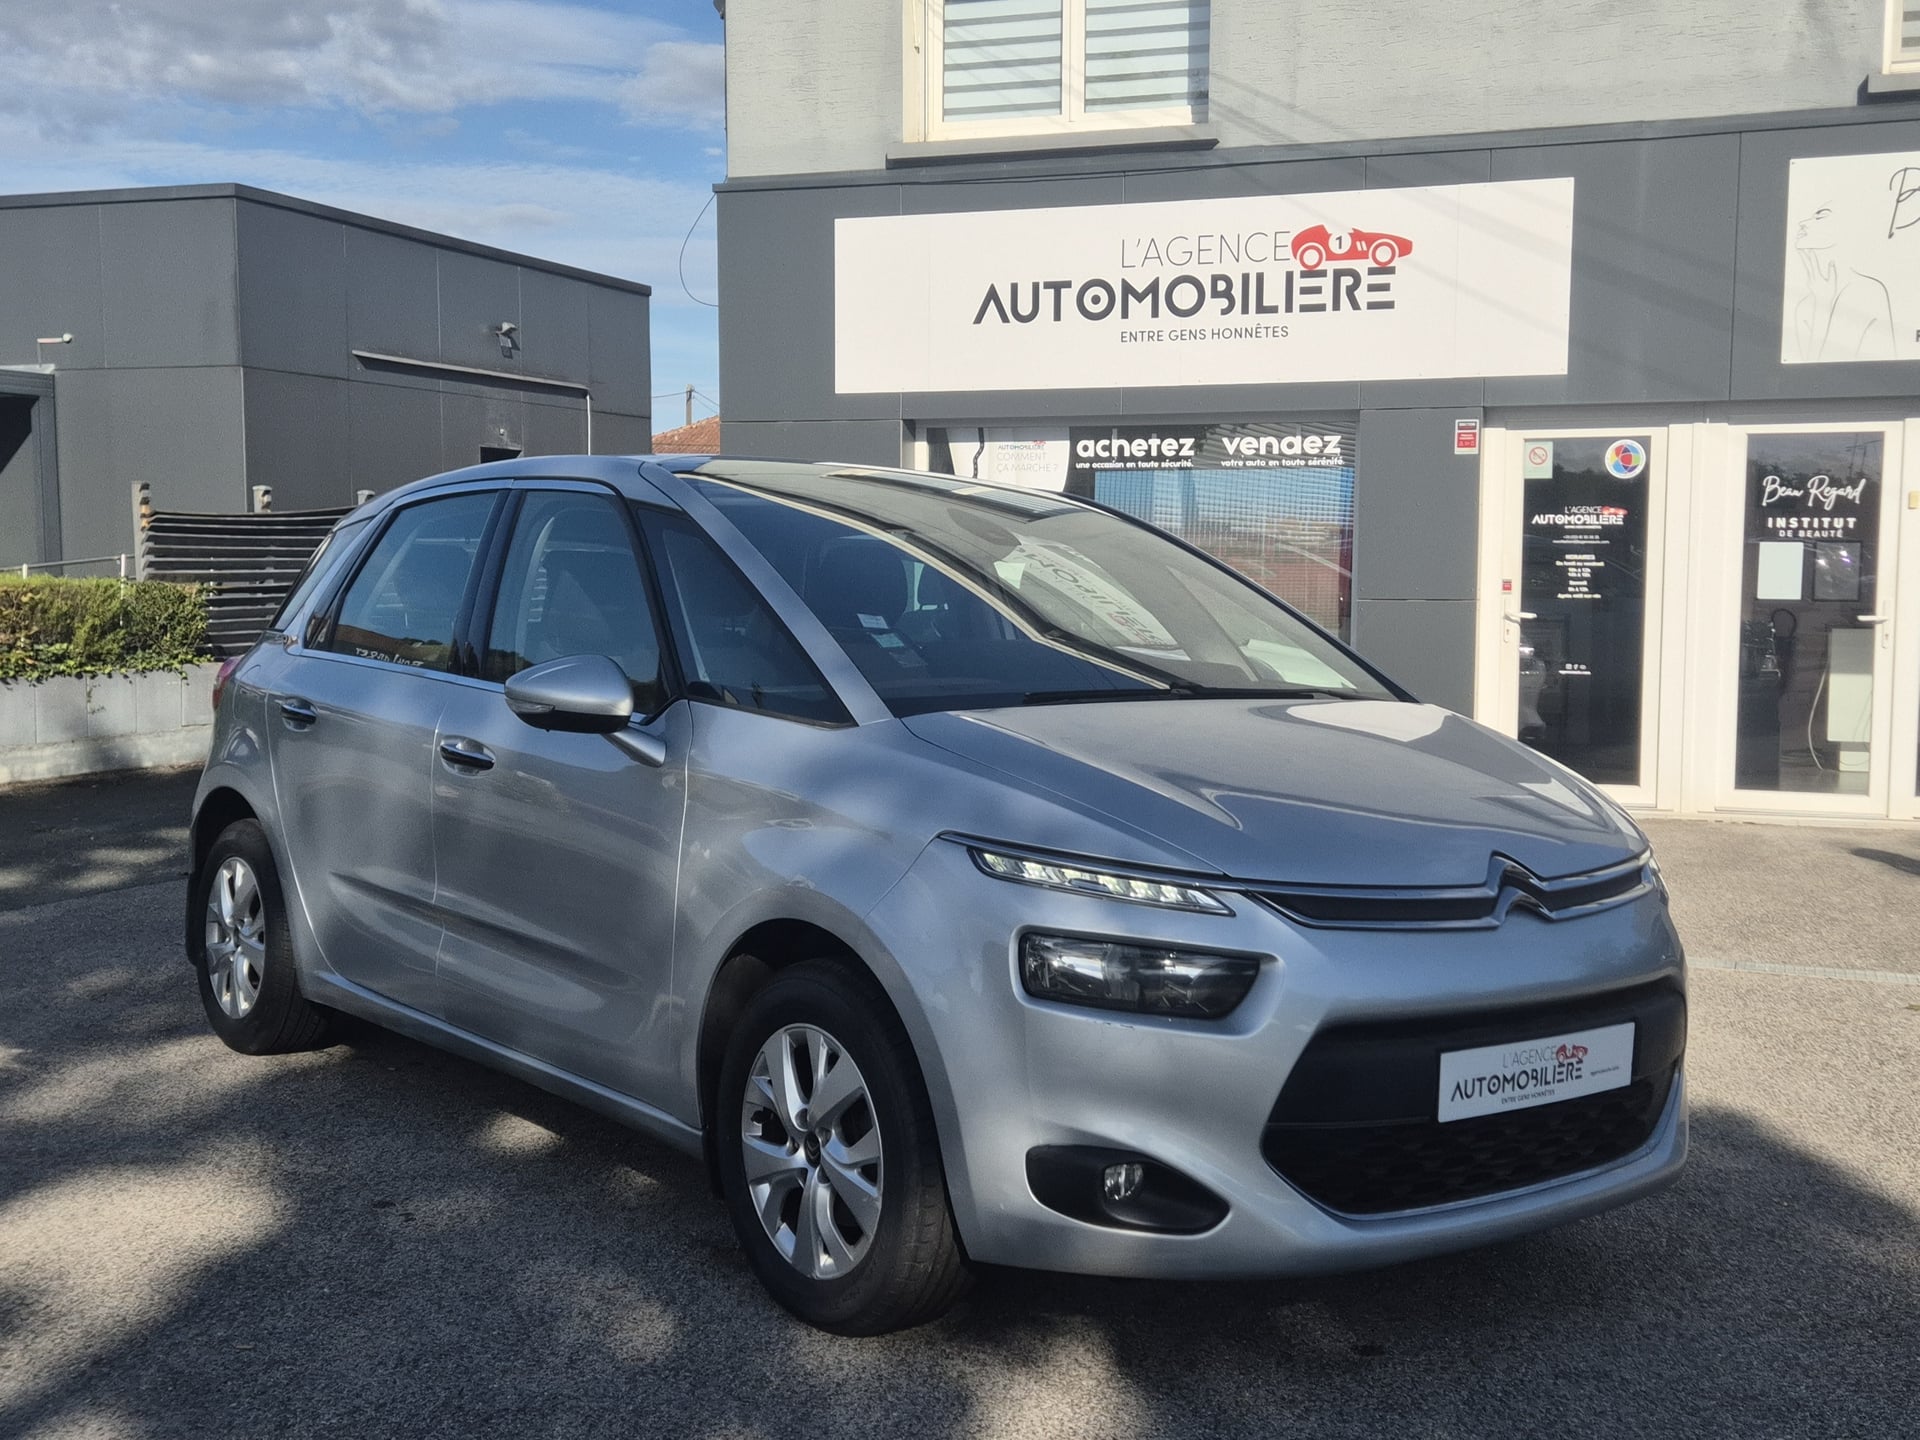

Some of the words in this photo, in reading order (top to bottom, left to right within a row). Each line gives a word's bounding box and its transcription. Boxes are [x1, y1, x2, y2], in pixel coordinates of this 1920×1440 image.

[1120, 231, 1291, 268] L'AGENCE
[1120, 330, 1164, 343] ENTRE
[1168, 327, 1206, 342] GENS
[1211, 322, 1289, 340] HONNÊTES
[1076, 428, 1195, 457] achetez
[1221, 425, 1342, 456] vendez
[997, 452, 1047, 462] COMMENT
[1245, 458, 1265, 466] auto
[1762, 475, 1804, 507] Beau
[1807, 475, 1867, 511] Regard
[1564, 505, 1602, 514] L'AGENCE
[1767, 517, 1857, 529] INSTITUT
[1502, 1045, 1557, 1068] L'AGENCE
